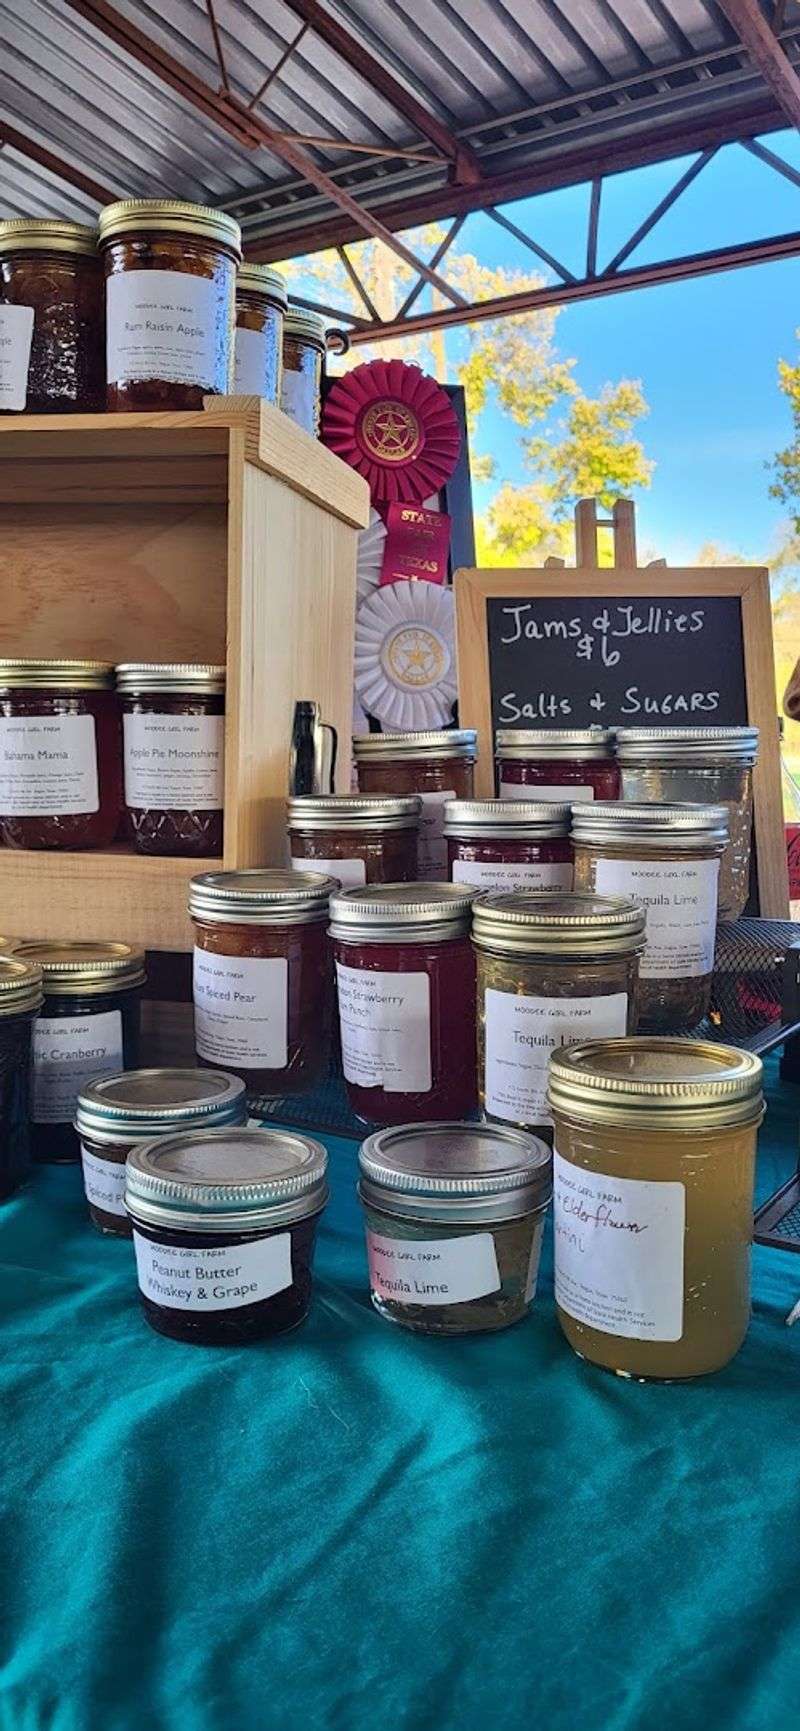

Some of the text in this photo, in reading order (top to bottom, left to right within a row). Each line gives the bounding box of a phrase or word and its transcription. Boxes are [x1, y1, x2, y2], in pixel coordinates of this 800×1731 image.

[124, 320, 206, 337] Rum Raisin Apple
[400, 509, 442, 527] STATE
[398, 554, 438, 573] TEXAS
[501, 604, 582, 644] Jams
[612, 605, 705, 637] Jellies
[499, 692, 572, 723] Salts
[37, 750, 69, 760] Mama
[130, 748, 219, 760] Apple Pie Moonshine
[628, 892, 699, 908] Tequila Lime
[233, 991, 257, 1003] Pear
[352, 989, 405, 1007] Strawberry
[569, 1009, 592, 1018] FARM
[513, 1030, 556, 1048] Tequila
[50, 1046, 107, 1062] Cranberry
[597, 1192, 622, 1204] FARM
[202, 1249, 226, 1259] FARM
[417, 1253, 442, 1263] FARM
[151, 1259, 242, 1281] Peanut Butter
[146, 1274, 259, 1303] Whiskey & Grape
[374, 1271, 449, 1294] Tequila Lime
